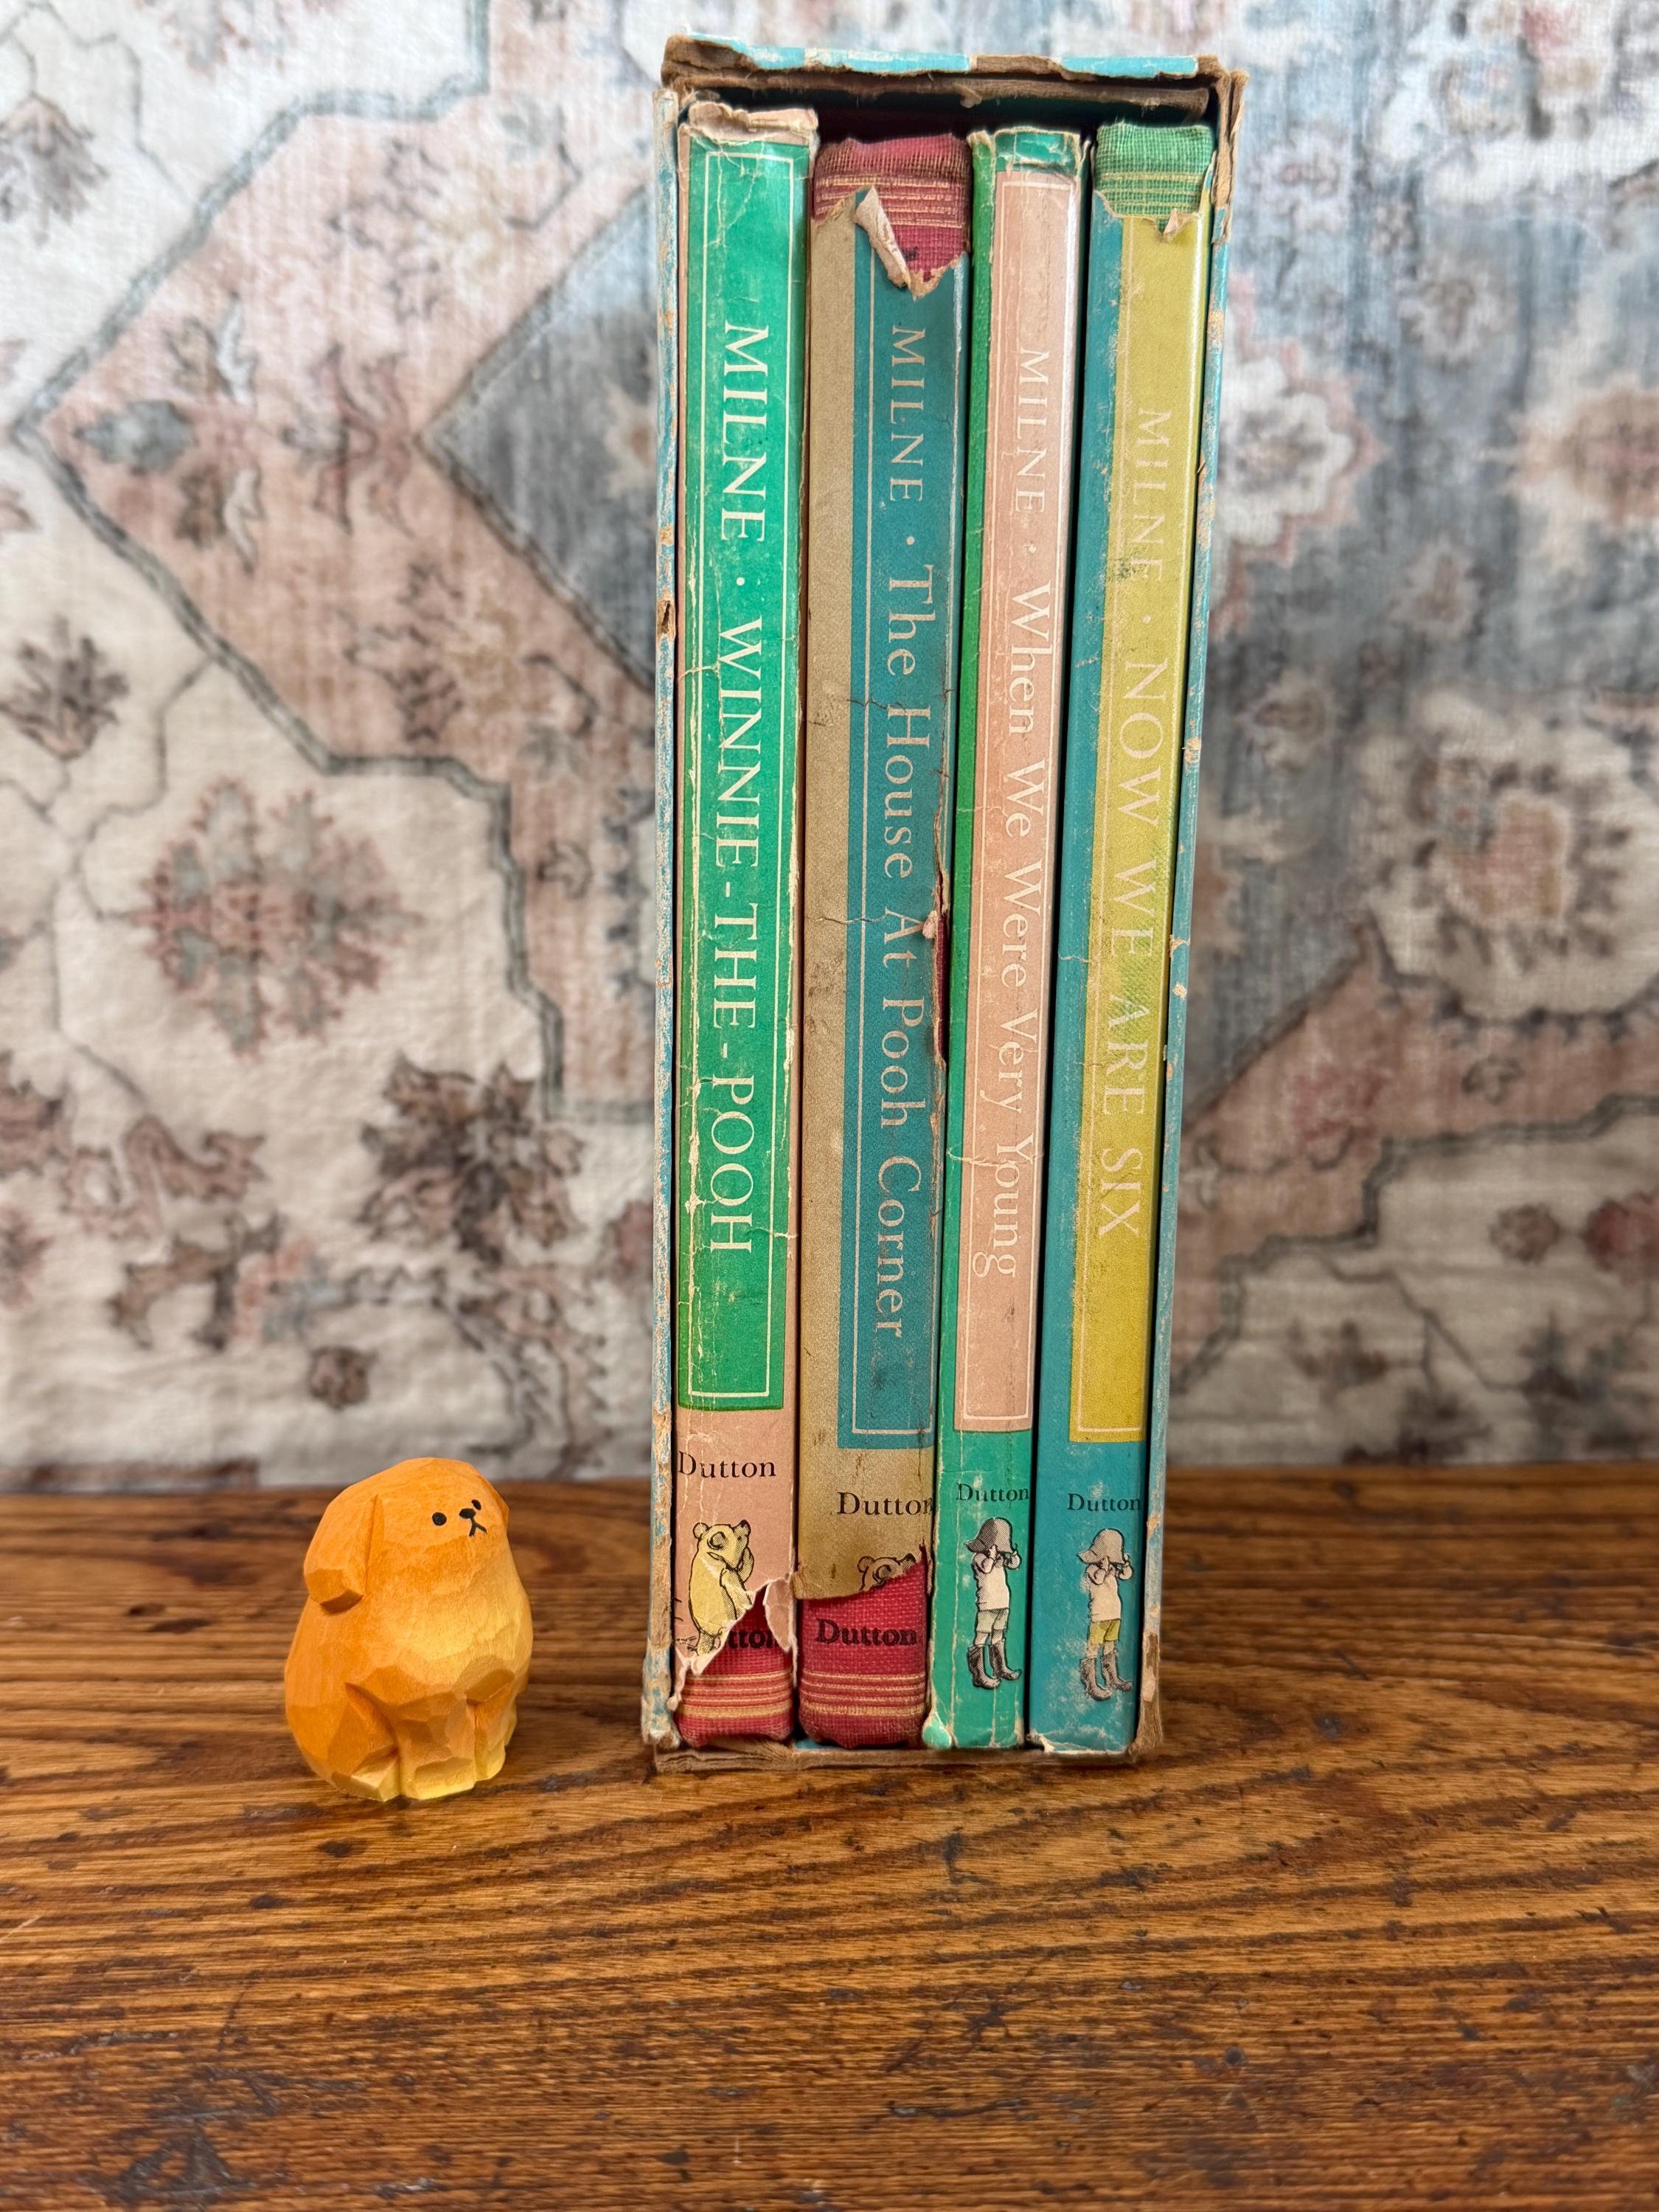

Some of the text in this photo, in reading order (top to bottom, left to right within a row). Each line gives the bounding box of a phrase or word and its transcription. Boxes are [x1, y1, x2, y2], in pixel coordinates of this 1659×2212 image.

[721, 322, 769, 542] MILNE
[875, 324, 936, 1337] MILNE The House At Pooh Corner
[971, 348, 1053, 1279] MILNE When We Were Very Young
[1098, 407, 1171, 1238] MILNE NOW WE ARE SIX
[678, 1451, 776, 1478] Dutton
[956, 1484, 1029, 1503] Dutton
[1067, 1493, 1141, 1511] Dutton
[815, 1618, 917, 1646] Dutton
